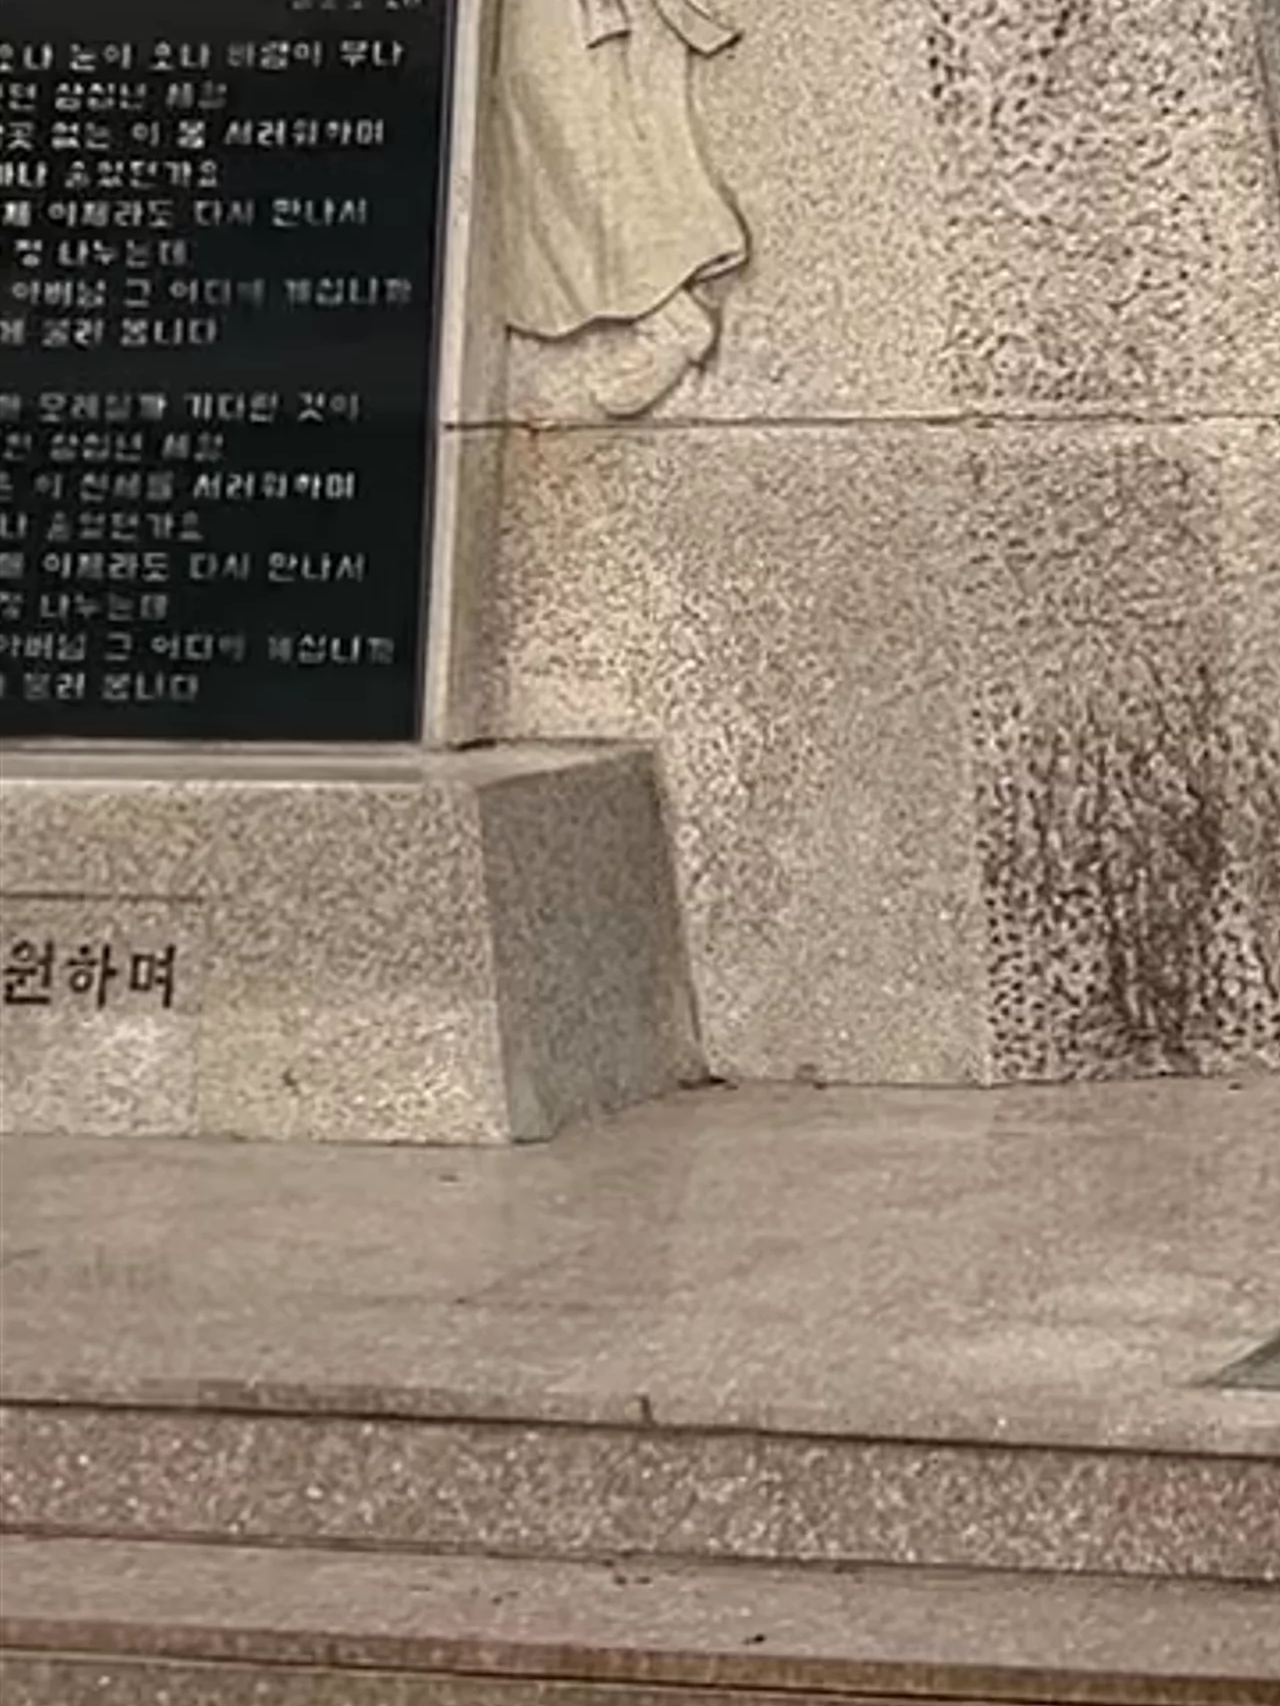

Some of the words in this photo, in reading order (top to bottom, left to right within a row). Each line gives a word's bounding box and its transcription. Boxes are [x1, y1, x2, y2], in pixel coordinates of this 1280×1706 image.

[148, 40, 209, 72] 오나
[0, 83, 37, 110] 던
[0, 121, 35, 151] 곳
[132, 120, 160, 148] 이
[192, 198, 256, 227] 다시
[122, 279, 152, 308] 그
[189, 551, 251, 582] 다시
[104, 632, 133, 662] 그
[3, 939, 177, 1008] 원하며
